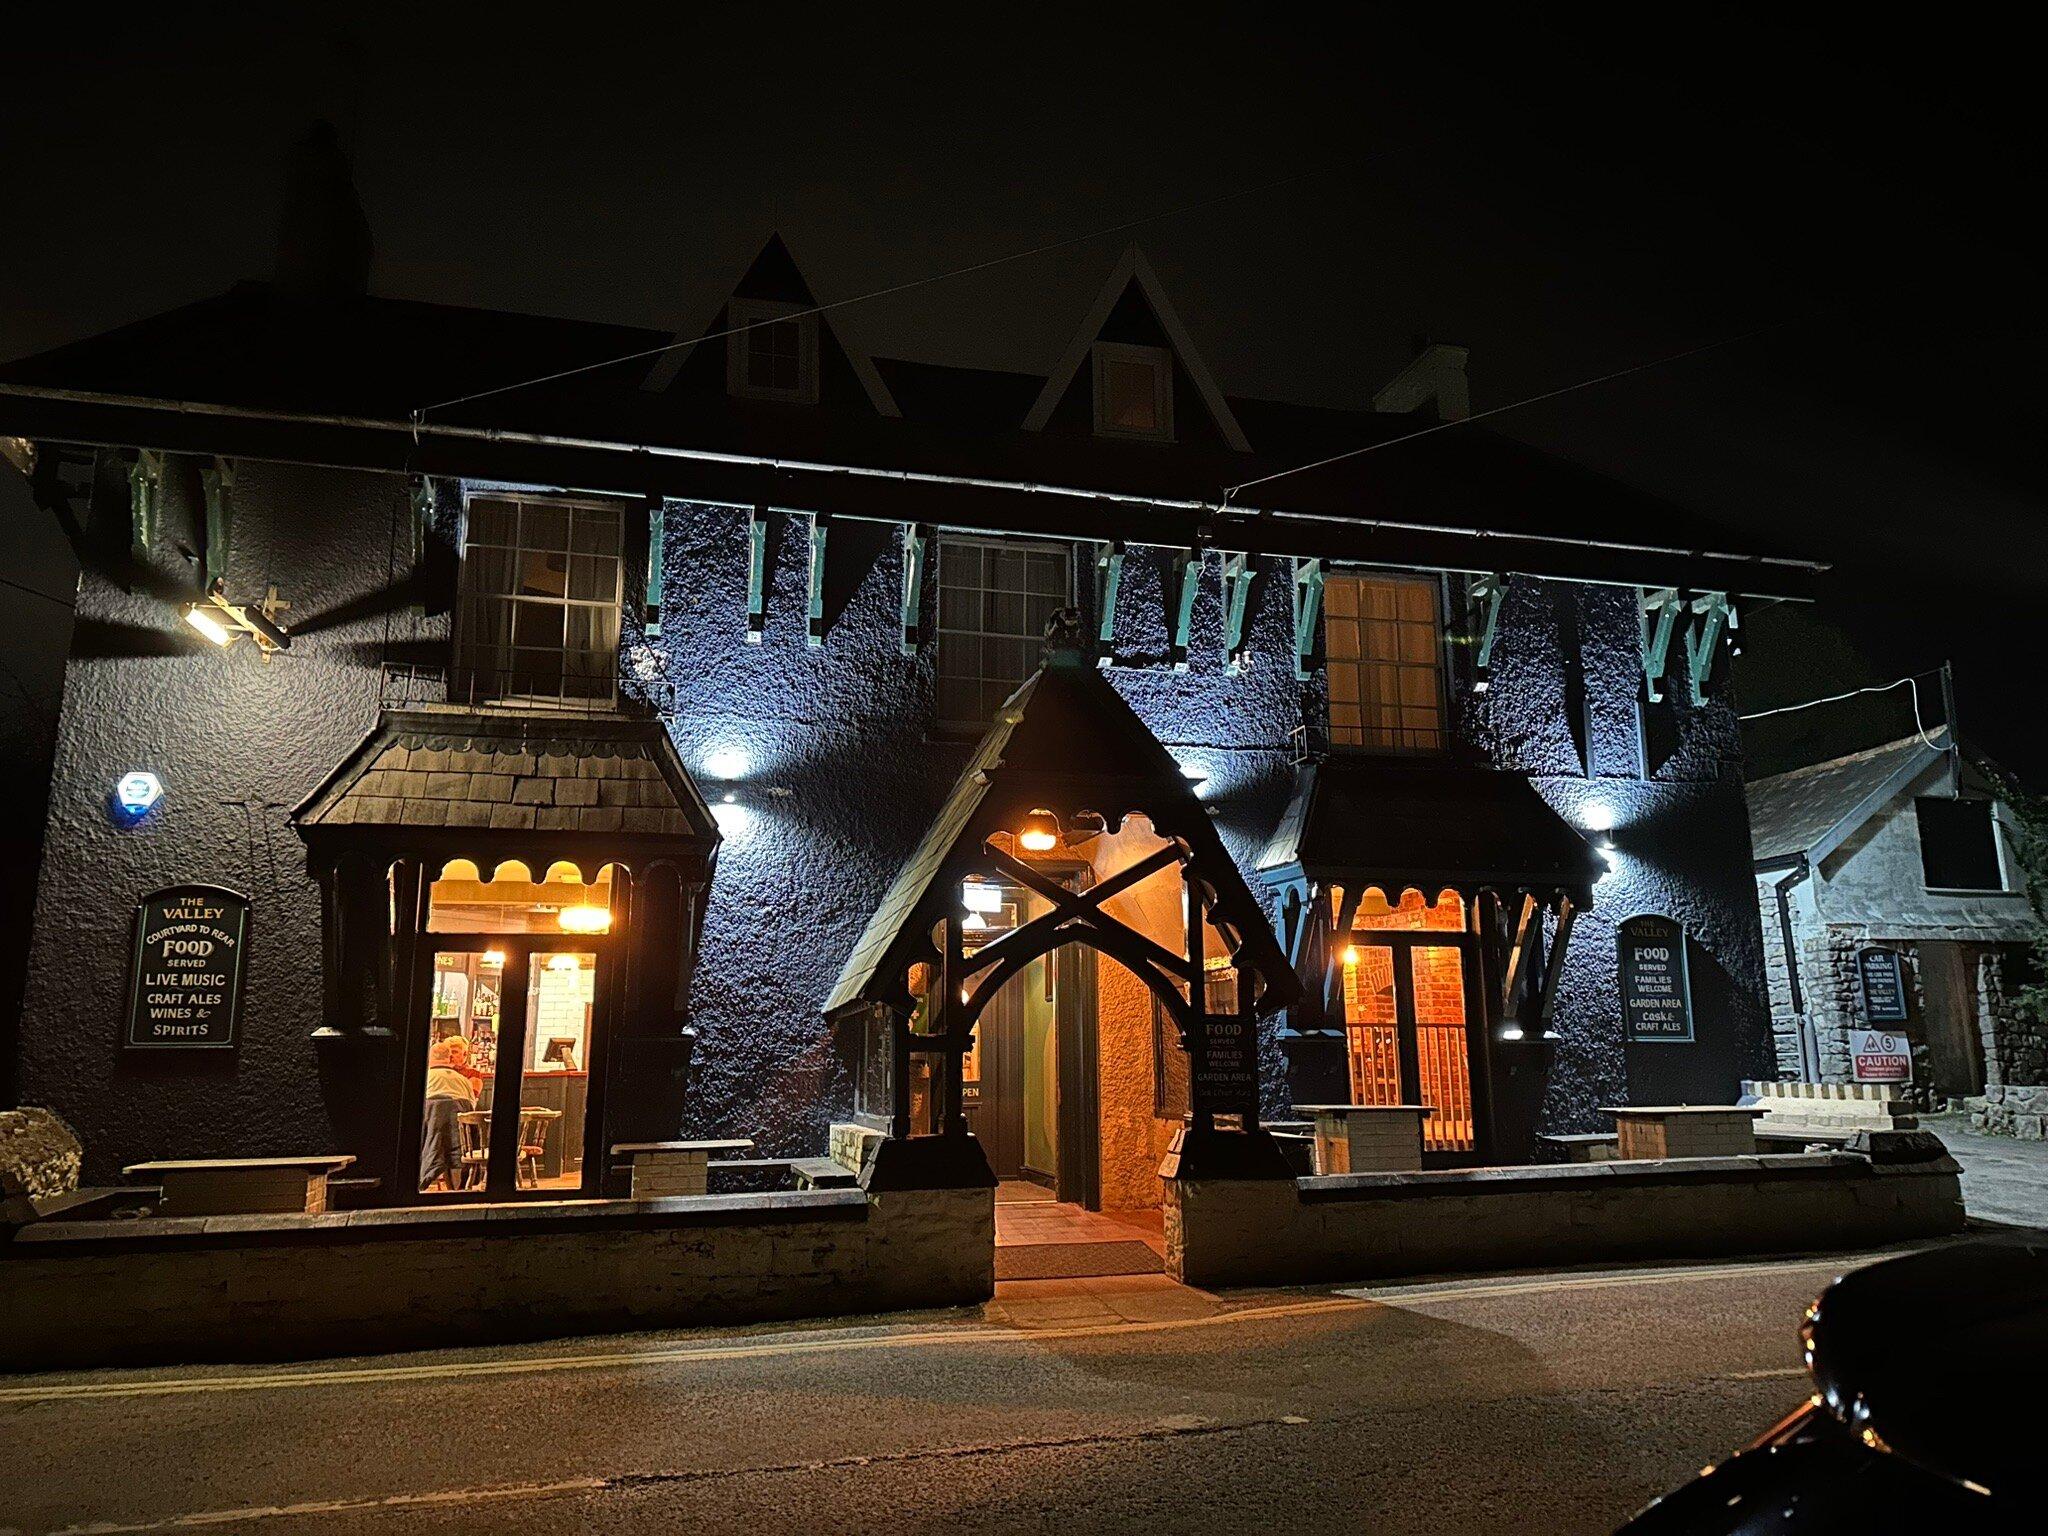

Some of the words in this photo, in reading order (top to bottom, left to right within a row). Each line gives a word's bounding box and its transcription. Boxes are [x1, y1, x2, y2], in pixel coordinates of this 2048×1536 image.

[180, 898, 204, 906] THE
[163, 908, 224, 919] VALLEY
[1640, 920, 1655, 928] THE
[146, 924, 198, 945] COURTYARD
[199, 924, 210, 935] TO
[211, 928, 235, 948] REAR
[1630, 927, 1669, 937] VALLEY
[162, 940, 214, 958] FOOD
[1634, 947, 1669, 962] FOOD
[167, 959, 206, 968] SERVED
[1639, 964, 1667, 972] SERVED
[145, 973, 179, 986] LIVE
[181, 974, 226, 986] MUSIC
[1634, 975, 1672, 984] FAMILIES
[1637, 984, 1673, 993] WELCOME
[147, 993, 184, 1004] CRAFT
[188, 994, 222, 1005] ALES
[1629, 998, 1660, 1008] GARDEN
[1661, 999, 1682, 1008] AREA
[150, 1008, 192, 1019] WINES
[196, 1008, 212, 1019] &
[1642, 1011, 1667, 1021] Cask
[153, 1024, 209, 1036] SPIRITS
[1206, 1024, 1242, 1035] FOOD
[1635, 1022, 1659, 1031] CRAFT
[1662, 1023, 1681, 1031] ALES
[1884, 1037, 1892, 1049] 5
[1206, 1050, 1243, 1060] FAMILIES
[1858, 1056, 1907, 1066] CAUTION
[1197, 1072, 1229, 1081] GARDEN
[1230, 1072, 1252, 1081] AREA
[962, 1087, 979, 1097] PEN
